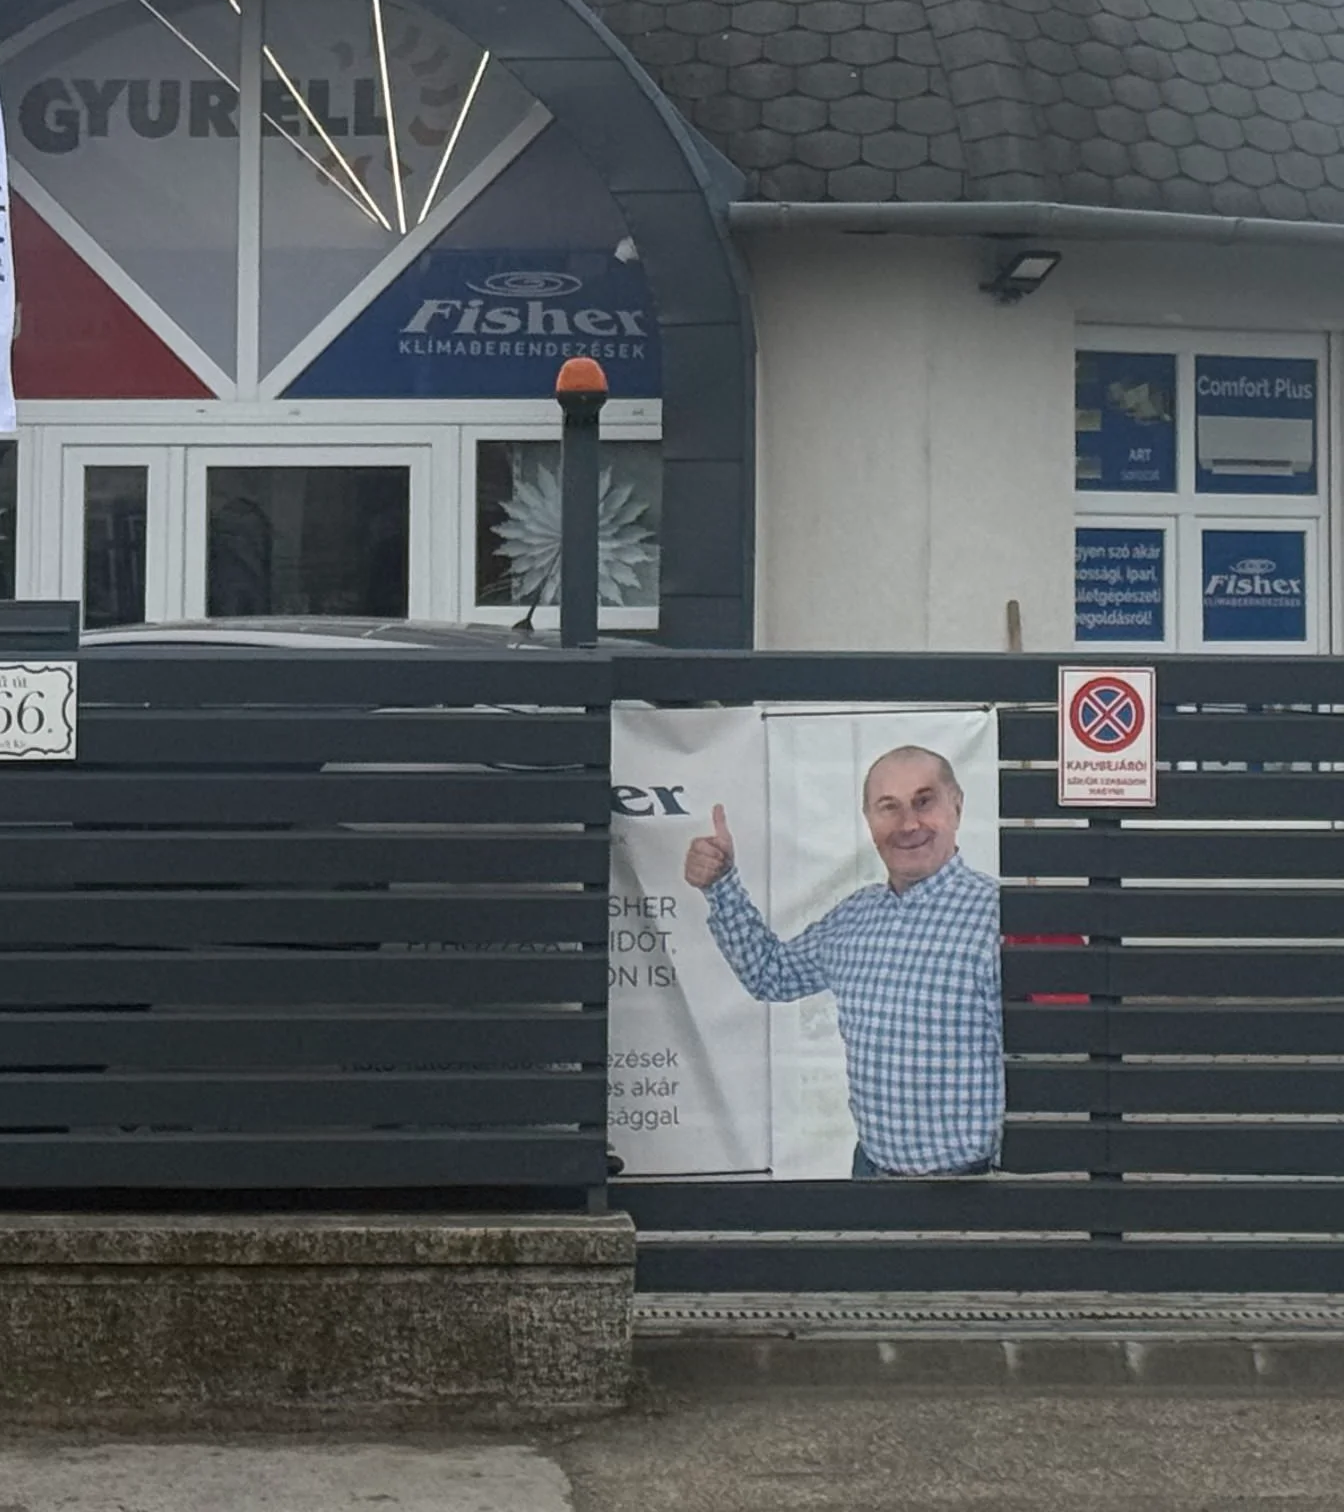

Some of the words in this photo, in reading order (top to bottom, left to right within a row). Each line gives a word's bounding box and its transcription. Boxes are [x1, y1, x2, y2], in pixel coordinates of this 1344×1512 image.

[18, 78, 390, 154] GYURELL
[399, 299, 648, 337] Fisher
[399, 338, 645, 360] KLÍMABERENDEZÉSEK
[1197, 375, 1271, 399] Comfort
[1275, 378, 1313, 399] Plus
[1204, 574, 1301, 595] Fisher
[647, 965, 676, 988] IS!
[631, 1076, 679, 1097] akár
